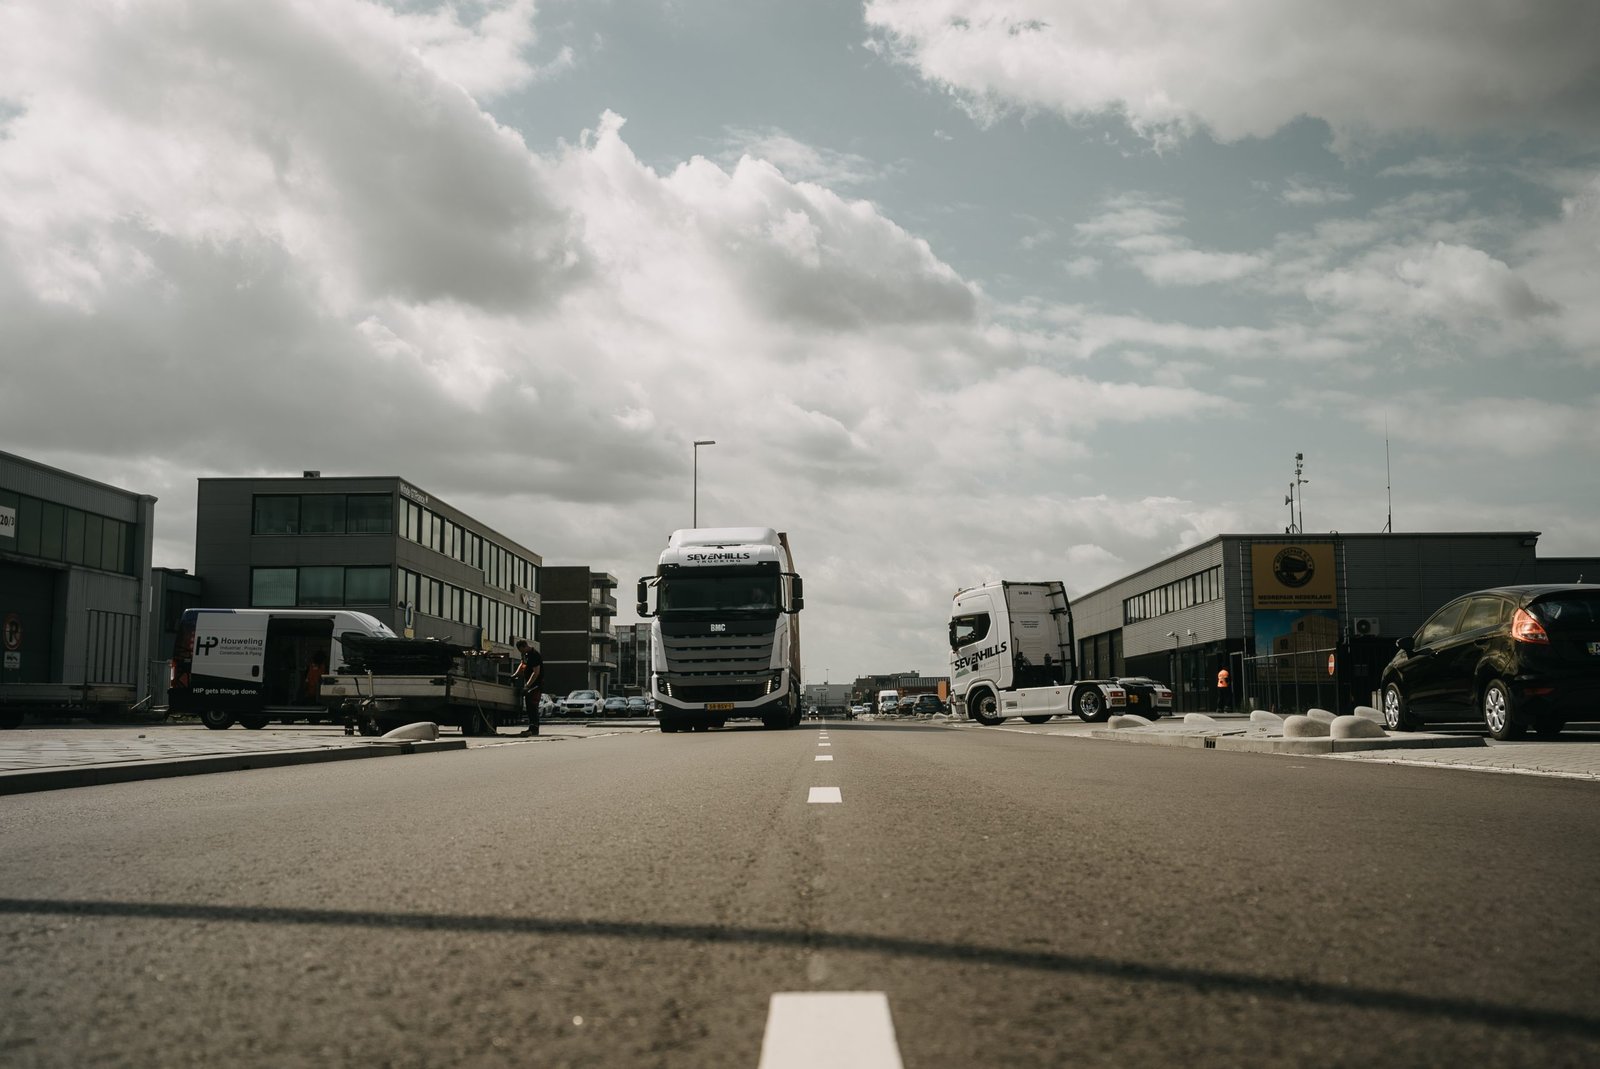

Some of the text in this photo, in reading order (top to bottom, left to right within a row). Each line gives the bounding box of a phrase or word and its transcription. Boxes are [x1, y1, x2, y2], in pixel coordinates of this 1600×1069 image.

[687, 552, 750, 561] SEVENHILLS
[221, 637, 263, 646] Houweling
[955, 641, 1007, 671] SEVENHILLS
